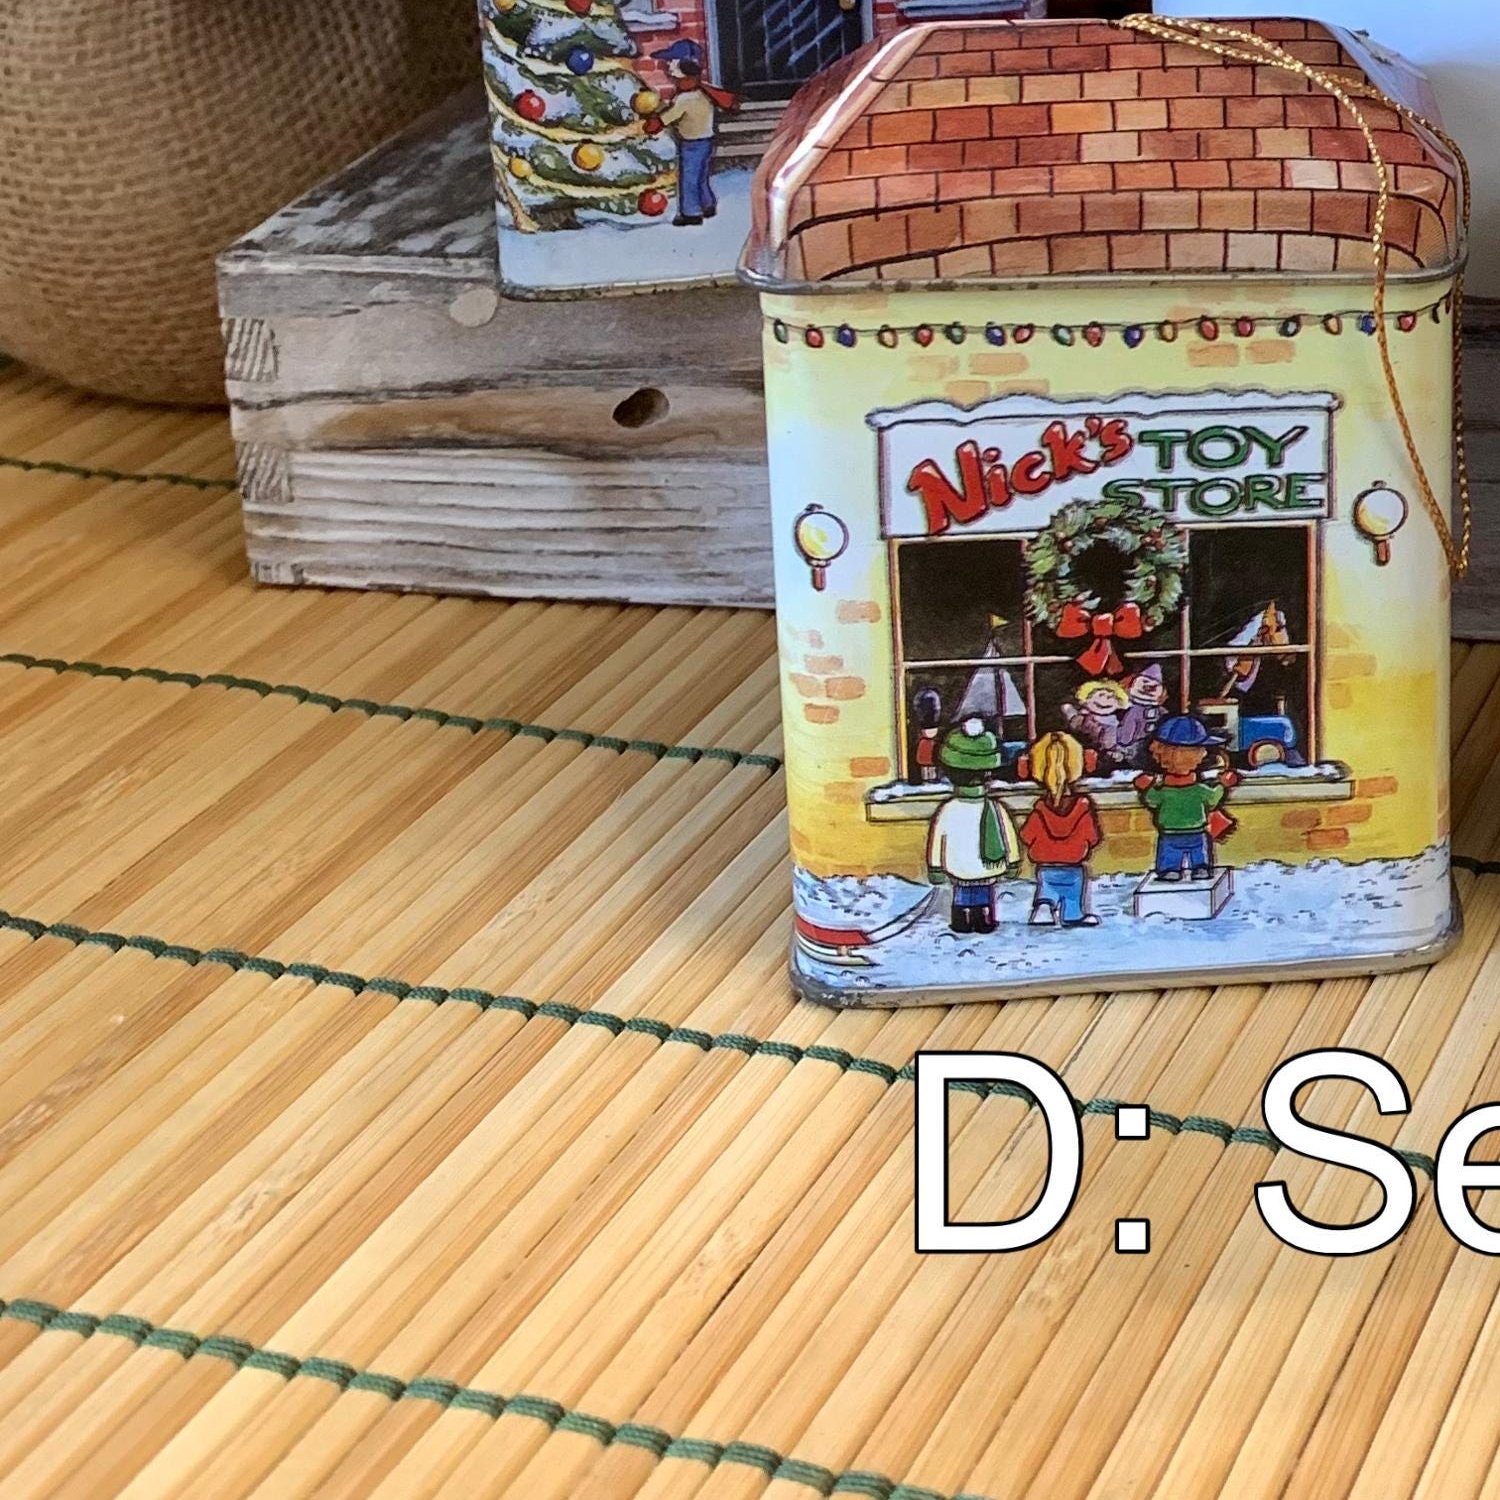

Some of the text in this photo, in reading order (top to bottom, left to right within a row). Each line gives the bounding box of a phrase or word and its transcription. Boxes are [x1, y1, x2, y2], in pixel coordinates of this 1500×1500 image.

[907, 415, 1310, 535] Nick's TOY
[1101, 472, 1328, 516] STORE
